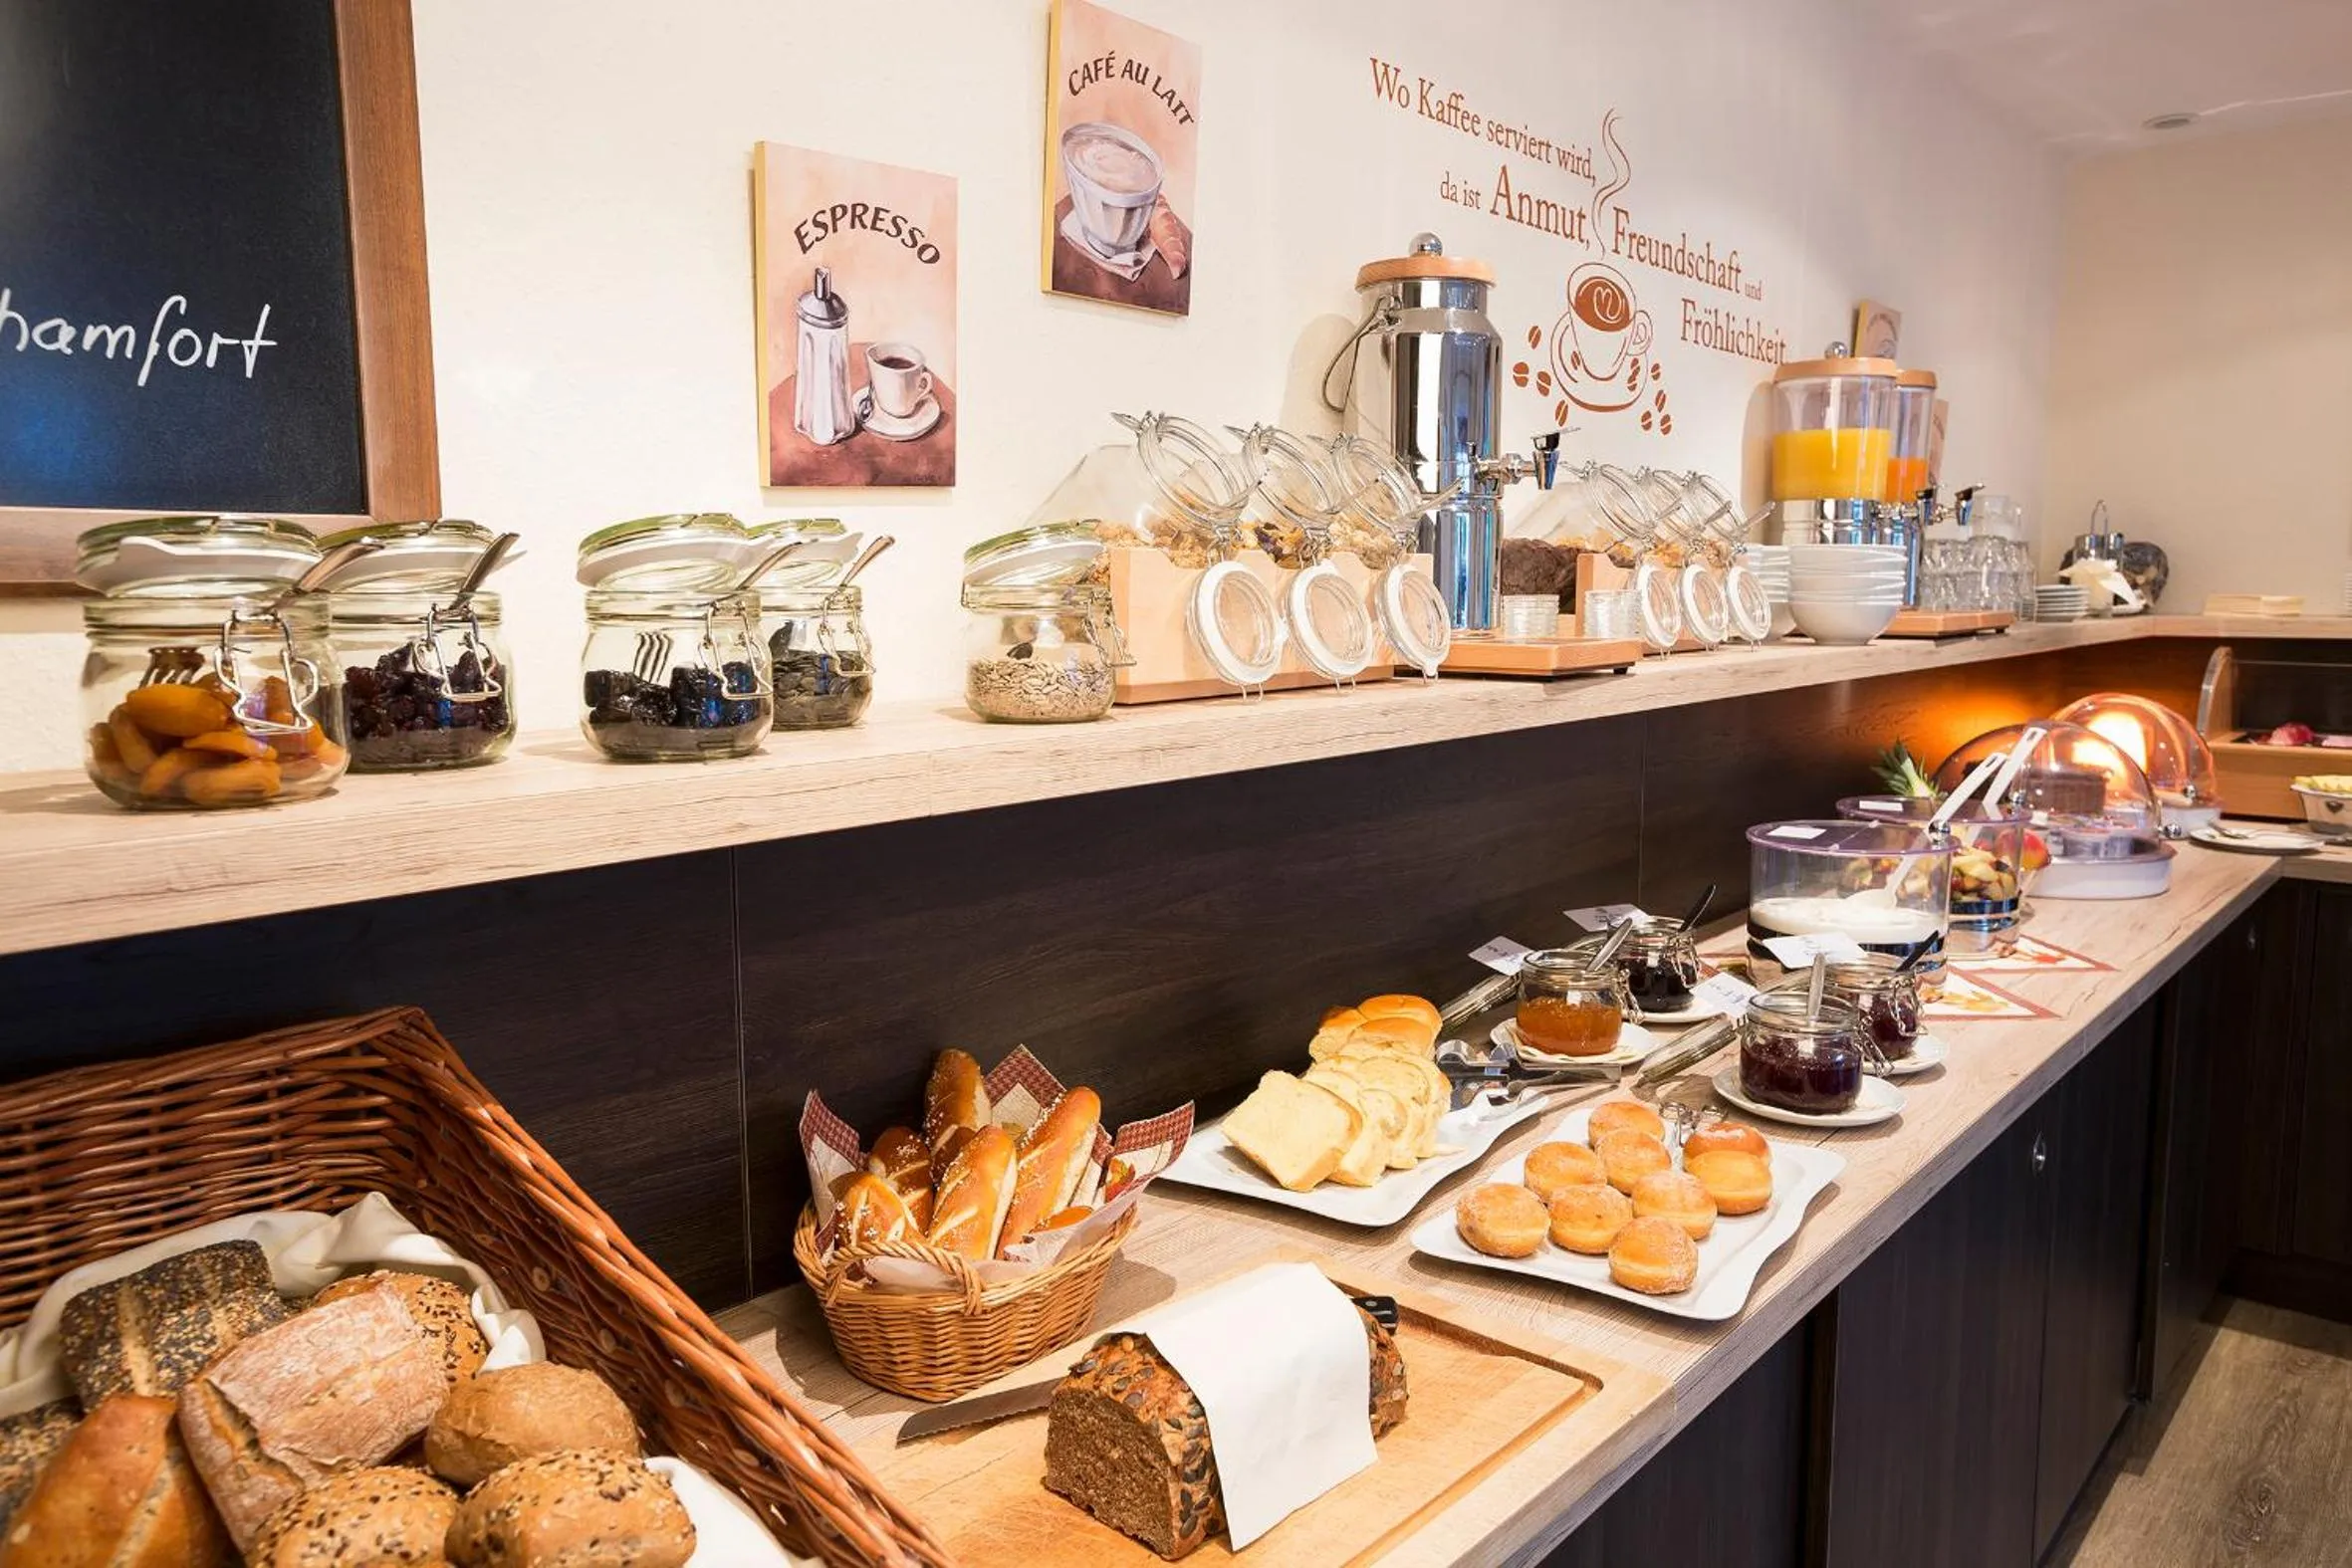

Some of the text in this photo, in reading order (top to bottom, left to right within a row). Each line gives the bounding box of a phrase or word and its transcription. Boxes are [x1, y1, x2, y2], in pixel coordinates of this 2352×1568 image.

[1068, 51, 1195, 125] CAFÉ AU LAIT
[1369, 57, 1597, 187] Wo Kaffee serviert wird,
[794, 202, 941, 265] ESPRESSO
[1440, 164, 1763, 302] da ist Anmut, Freundschaft und
[1681, 298, 1787, 364] Fröhlichkeit
